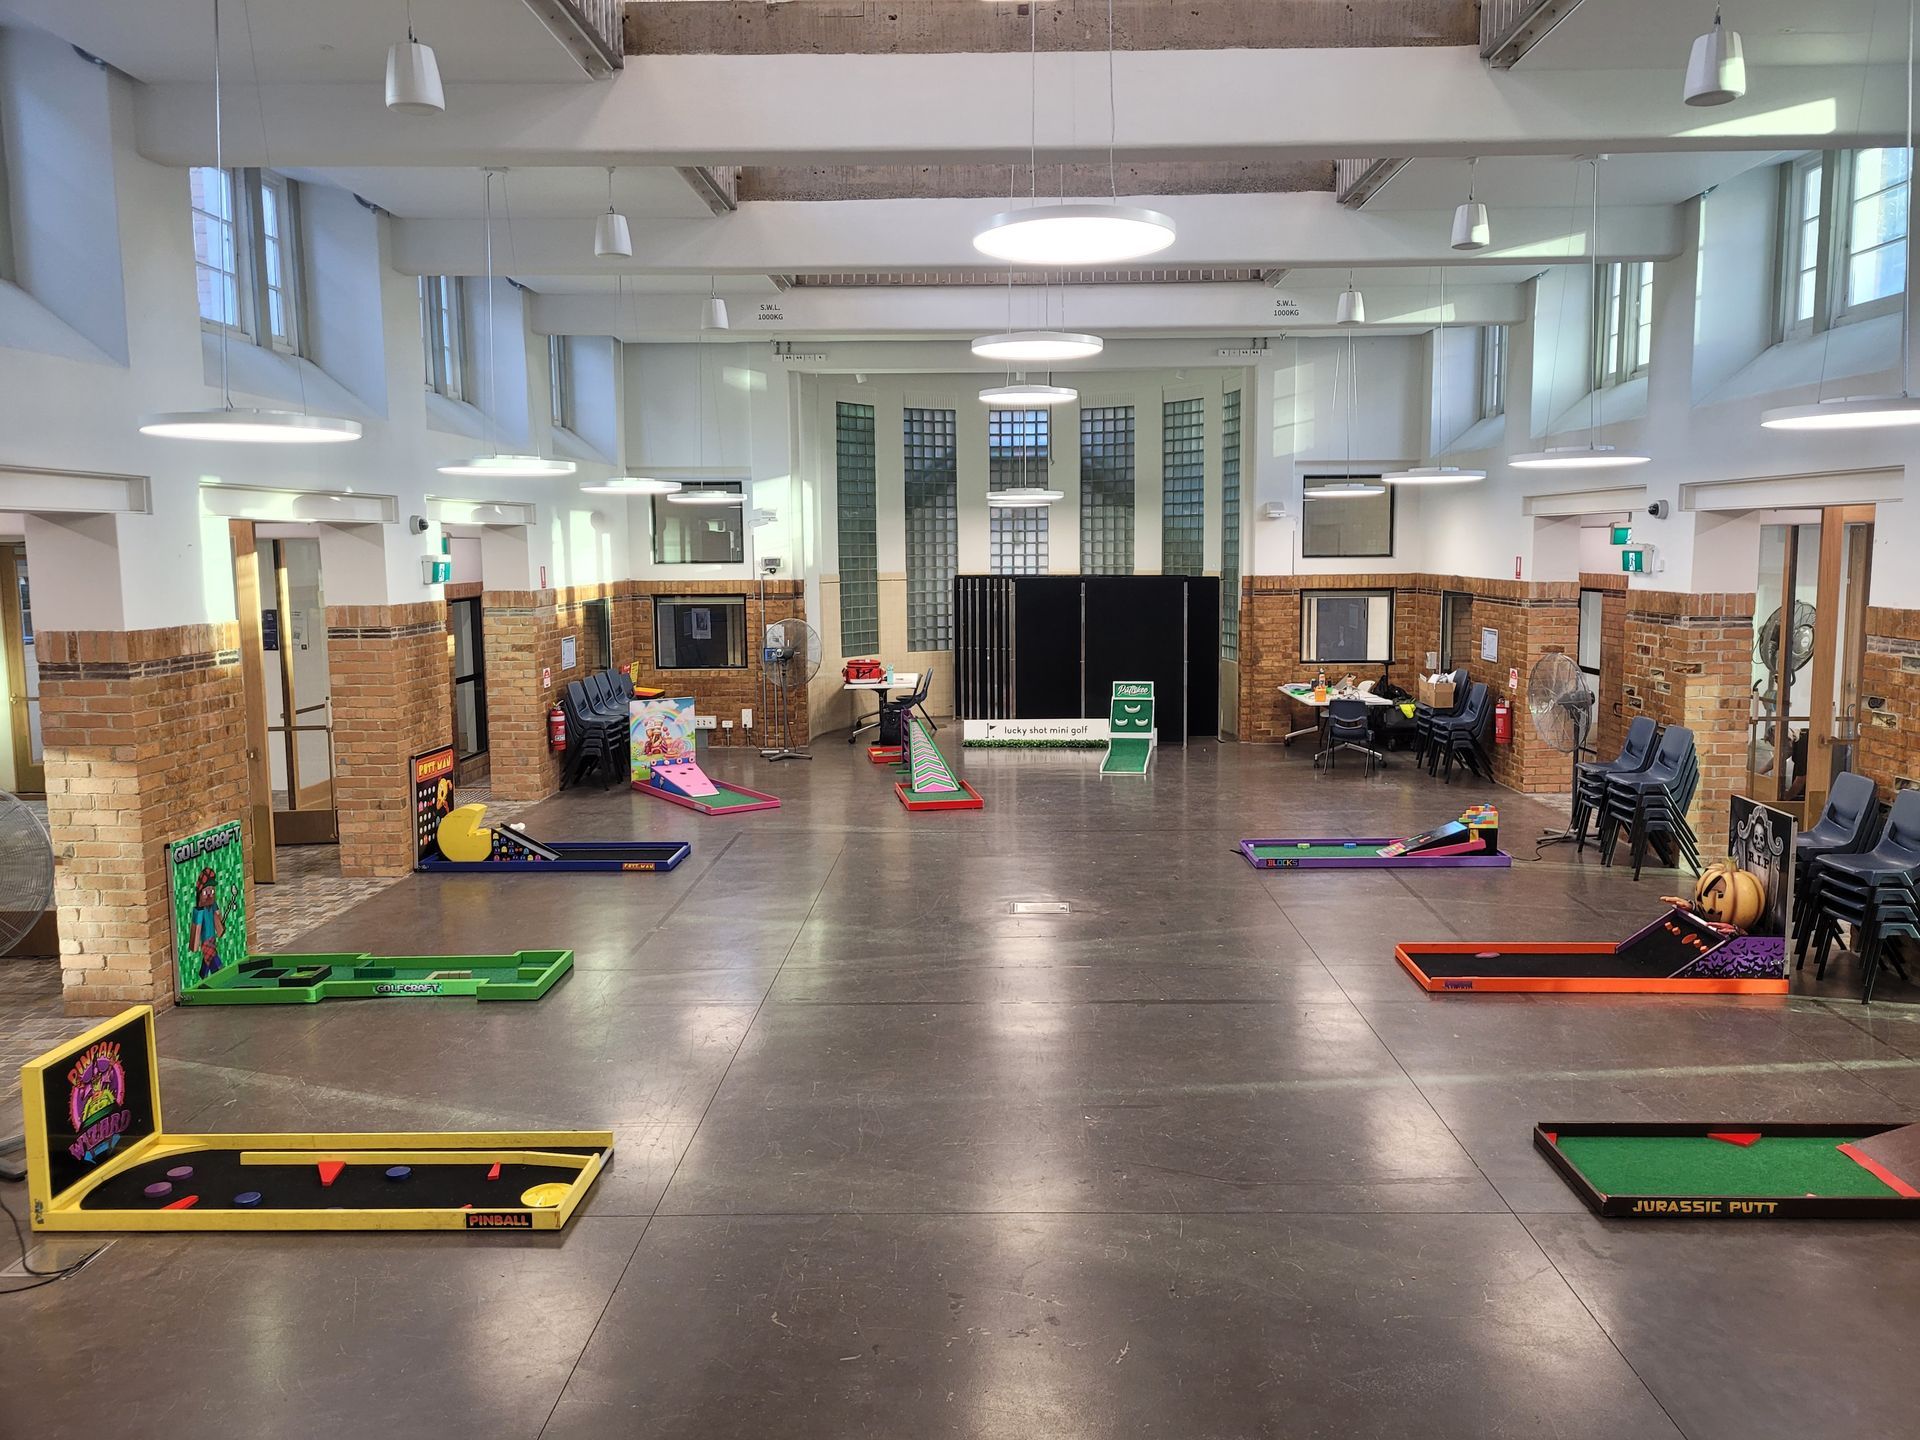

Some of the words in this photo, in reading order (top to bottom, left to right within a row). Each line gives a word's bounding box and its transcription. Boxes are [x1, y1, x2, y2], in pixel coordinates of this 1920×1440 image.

[1004, 726, 1027, 736] lucky
[1029, 726, 1047, 735] shot
[1049, 726, 1069, 735] mini
[1071, 725, 1088, 736] golf
[174, 825, 241, 864] GOLFCRAFT
[1267, 859, 1298, 867] BLOCKS
[376, 983, 439, 993] GOLFCRAFT
[68, 1109, 131, 1161] WIZARD
[1632, 1200, 1722, 1213] JURASSIC
[1729, 1201, 1779, 1213] PUTT
[469, 1214, 529, 1226] PINBALL
